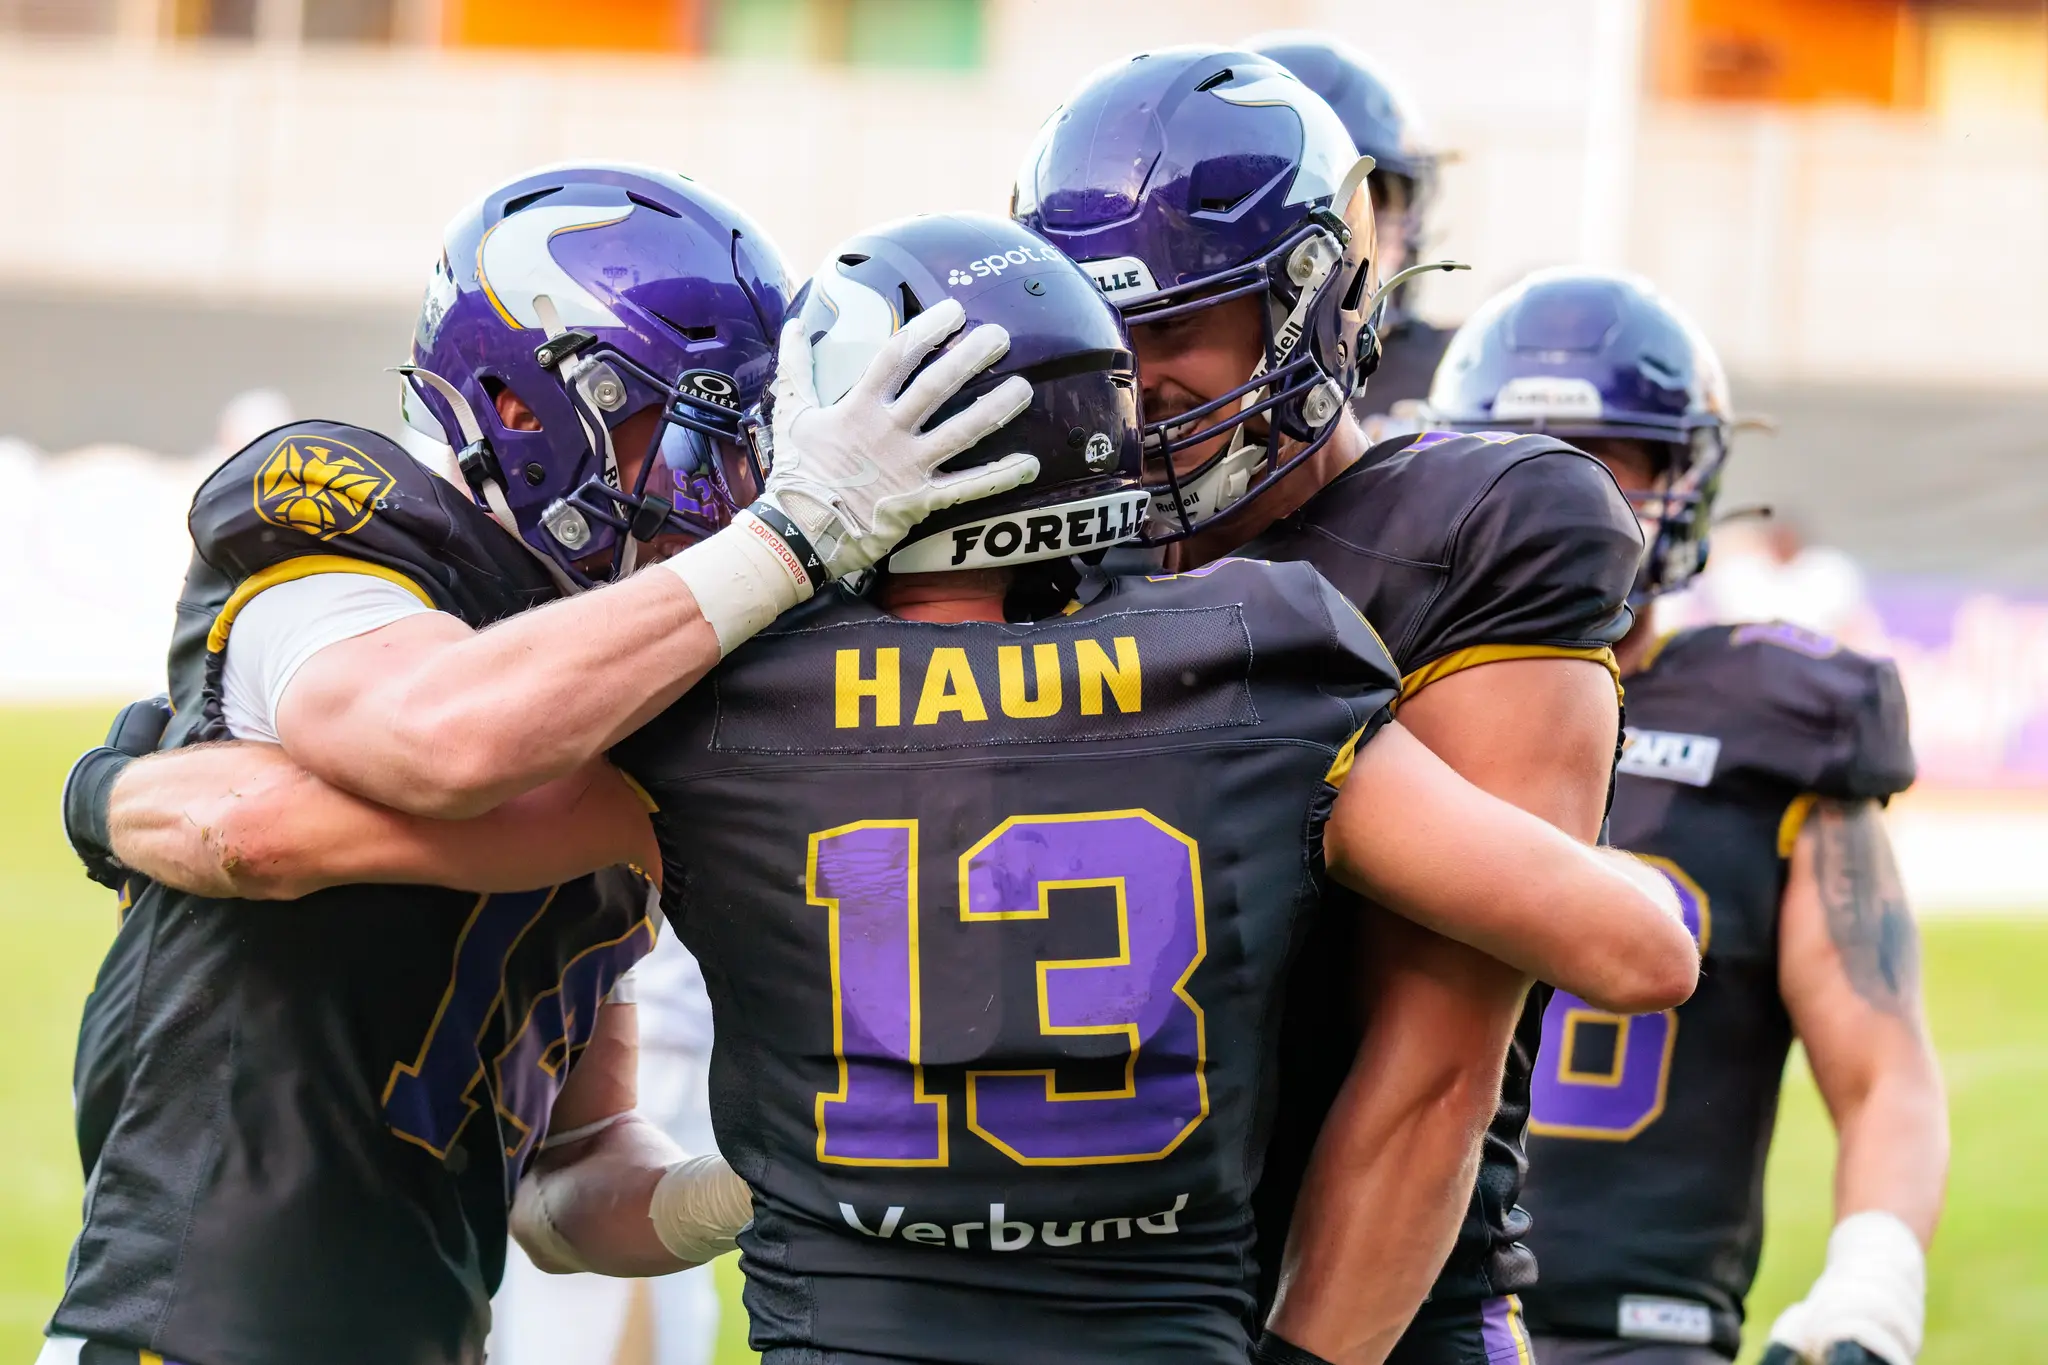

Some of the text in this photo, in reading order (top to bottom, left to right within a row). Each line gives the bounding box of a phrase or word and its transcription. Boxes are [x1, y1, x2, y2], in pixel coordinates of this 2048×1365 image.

[679, 384, 738, 409] OAKLEY
[952, 498, 1149, 566] FORELLE
[1156, 492, 1200, 512] Ridell
[748, 520, 807, 585] LONGHORNS
[835, 636, 1142, 728] HAUN
[806, 808, 1210, 1167] 13
[838, 1192, 1189, 1251] Verbund
